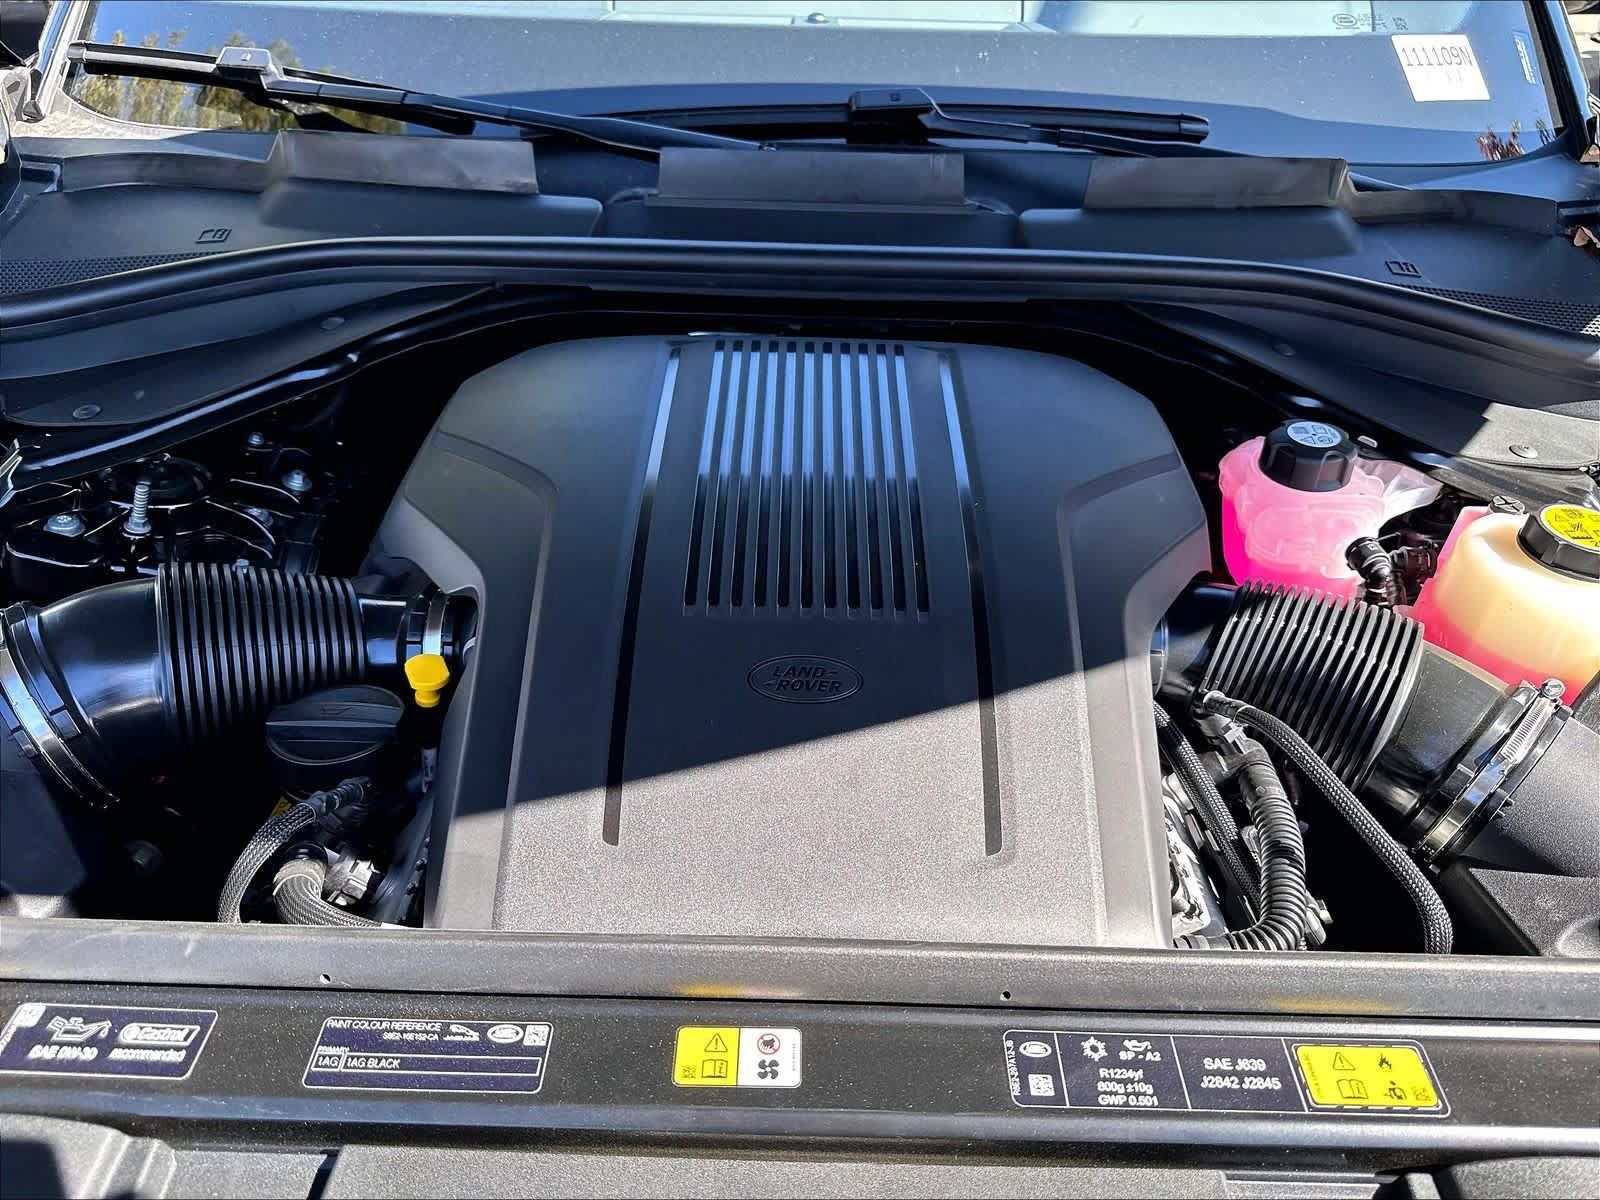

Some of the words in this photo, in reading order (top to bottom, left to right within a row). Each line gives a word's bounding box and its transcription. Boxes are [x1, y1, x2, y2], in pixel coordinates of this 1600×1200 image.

[1401, 46, 1473, 67] 111109N
[773, 666, 827, 678] LAND
[775, 679, 843, 692] ROVER
[326, 1019, 352, 1029] PAINT
[351, 1020, 391, 1030] COLOUR
[391, 1021, 443, 1031] REFERENCE
[318, 1056, 339, 1067] 1AG
[366, 1058, 400, 1069] BLACK
[1203, 1057, 1234, 1070] SAE
[1098, 1094, 1127, 1105] GWP
[1128, 1095, 1159, 1106] 0.501
